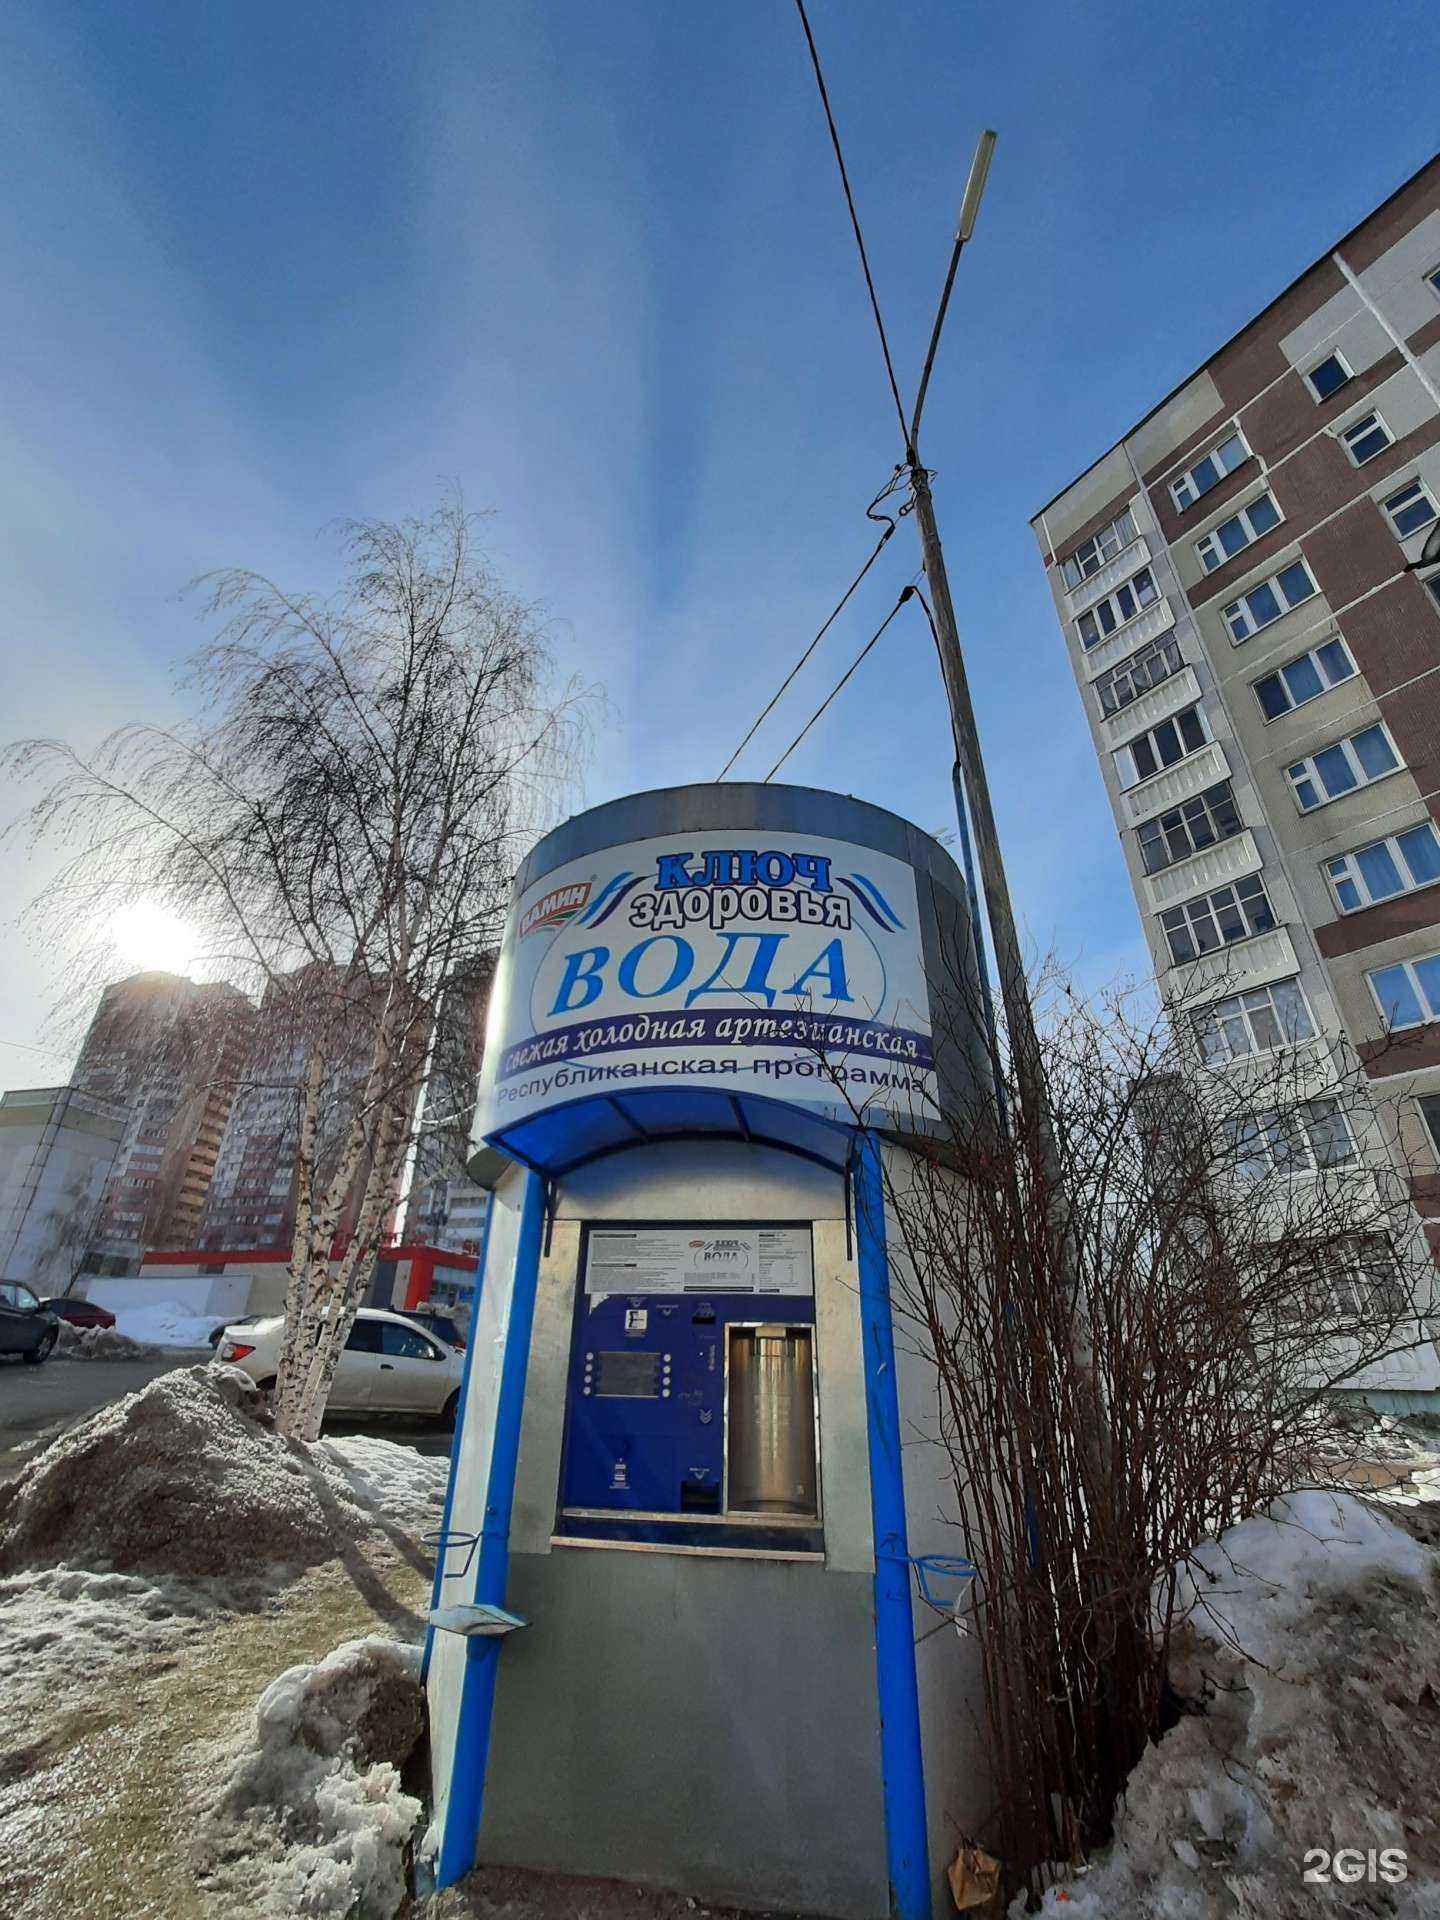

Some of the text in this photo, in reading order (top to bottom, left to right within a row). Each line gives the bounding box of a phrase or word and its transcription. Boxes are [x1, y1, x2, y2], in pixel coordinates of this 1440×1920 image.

[547, 932, 854, 1018] ВОДА
[572, 1015, 706, 1053] холодная
[715, 1015, 919, 1059] артезианская
[753, 1059, 925, 1093] программа
